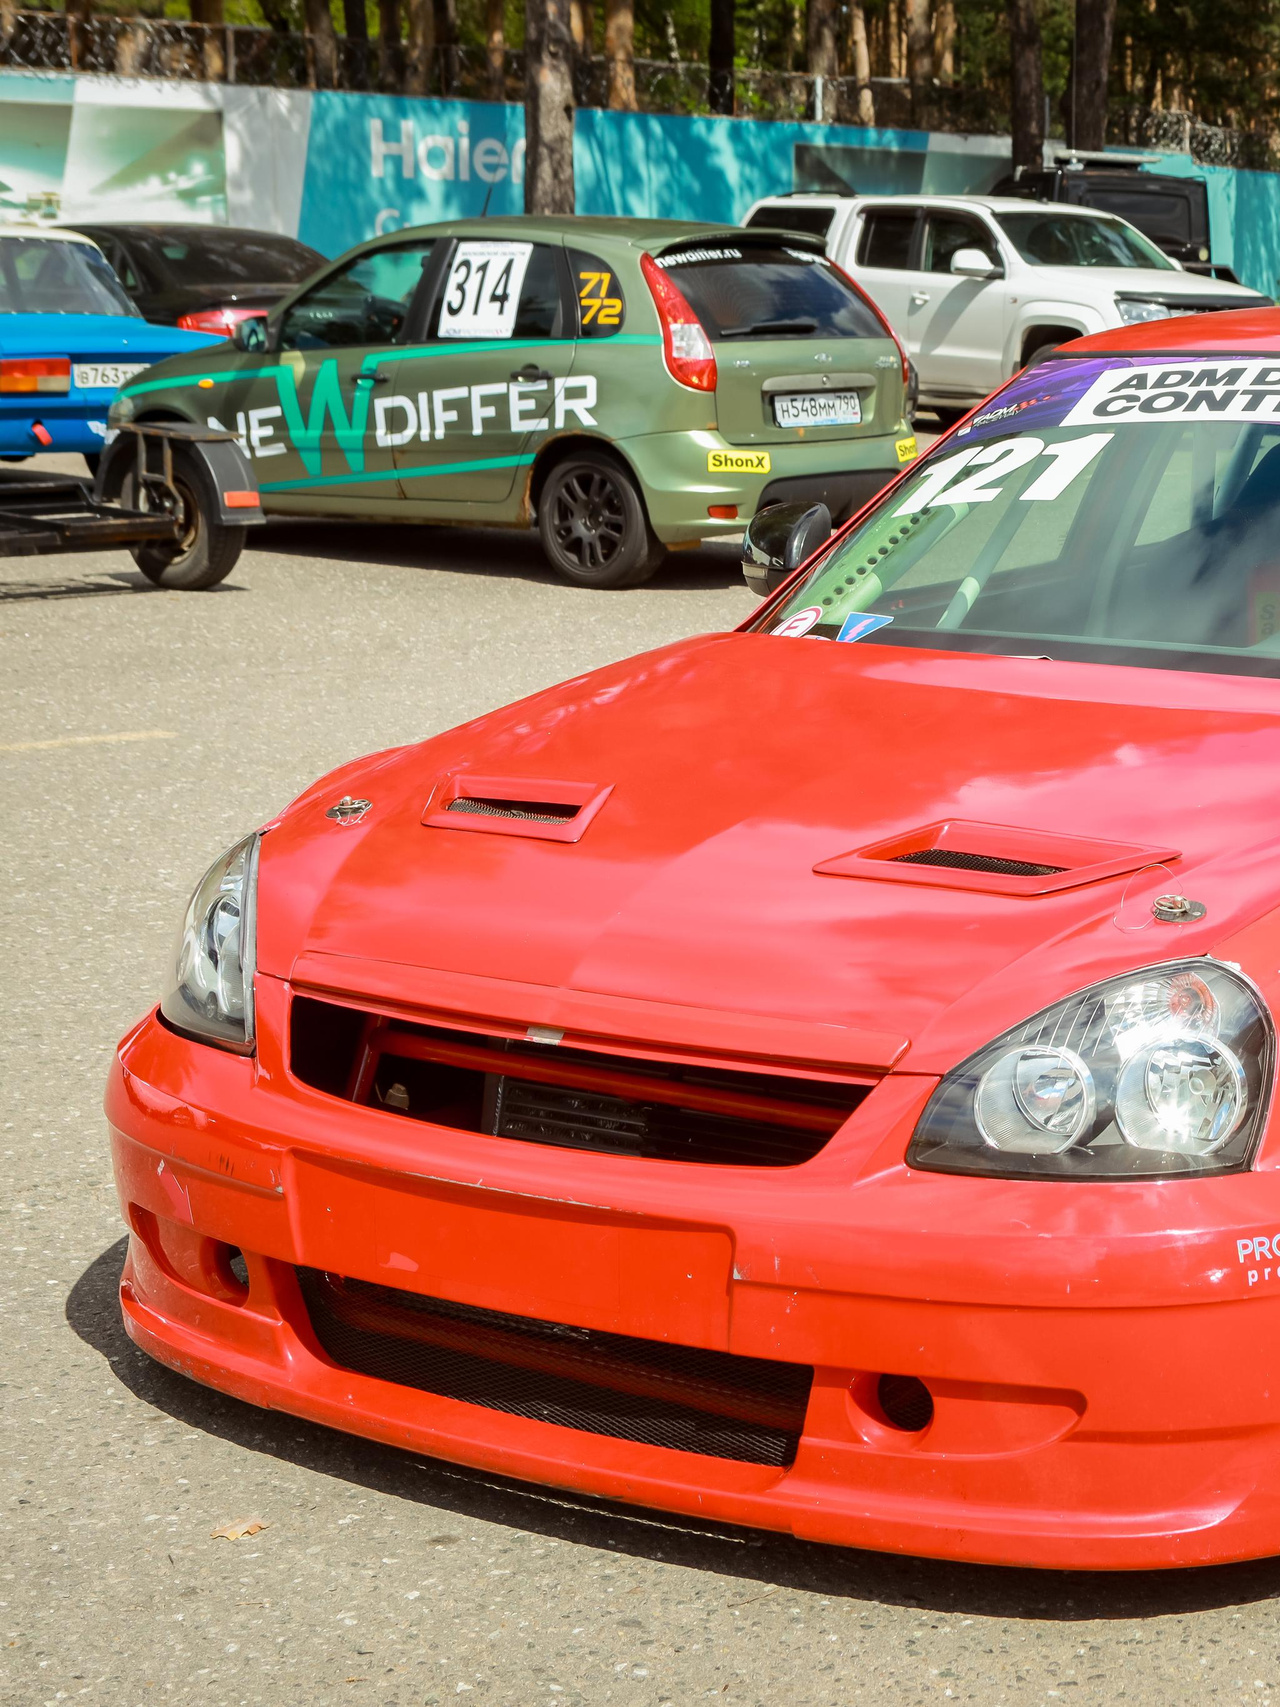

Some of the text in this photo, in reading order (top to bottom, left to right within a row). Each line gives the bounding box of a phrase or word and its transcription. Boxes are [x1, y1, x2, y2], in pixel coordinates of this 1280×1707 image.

[370, 117, 527, 185] Haier
[447, 257, 515, 317] 314
[579, 271, 612, 298] 71
[580, 298, 623, 325] 72
[1107, 367, 1248, 393] ADM
[712, 454, 765, 469] ShonX
[891, 432, 1115, 518] 121
